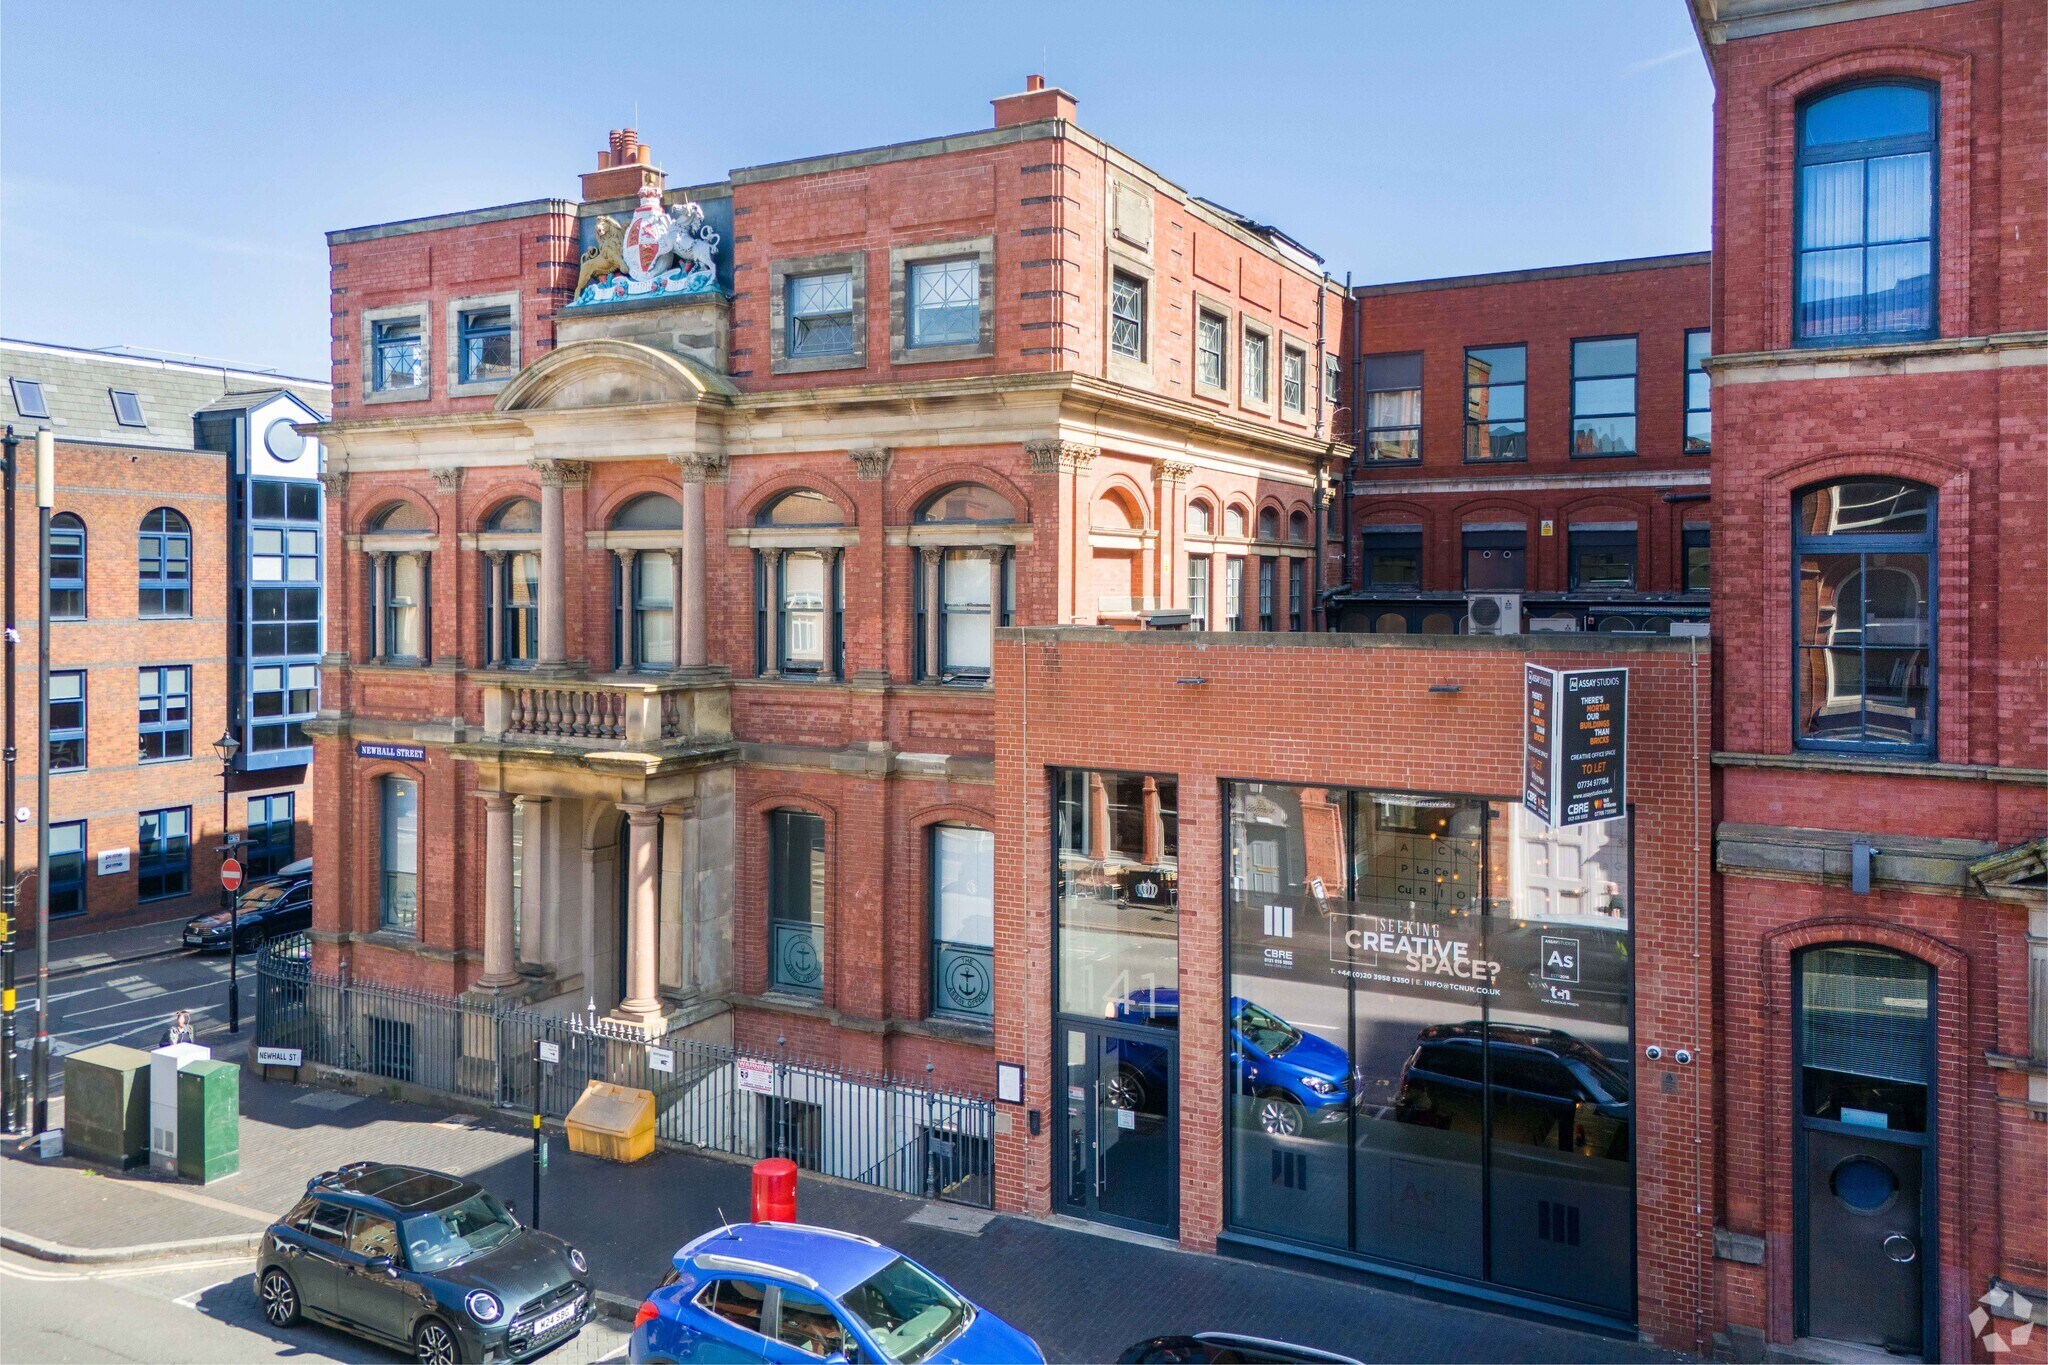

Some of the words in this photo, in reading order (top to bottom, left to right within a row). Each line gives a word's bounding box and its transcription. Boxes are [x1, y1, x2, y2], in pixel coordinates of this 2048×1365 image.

[1579, 679, 1597, 688] ASSAY
[1596, 677, 1620, 686] STUDIOS
[1580, 696, 1604, 704] THERE'S
[1586, 704, 1610, 712] MORTAR
[1580, 720, 1610, 730] BUILDINGS
[1594, 728, 1610, 736] THAN
[1590, 736, 1610, 745] BRICKS
[362, 746, 395, 756] NEWHALL
[396, 748, 424, 758] STREET
[1582, 764, 1592, 774] TO
[1594, 761, 1606, 773] LET
[1576, 780, 1592, 790] 07734
[1568, 802, 1589, 815] CBRE
[1380, 918, 1440, 938] SEEKING
[1345, 930, 1468, 961] CREATIVE
[1264, 948, 1293, 960] CBRE
[1548, 950, 1574, 968] As
[962, 957, 973, 965] THE
[1406, 952, 1501, 982] SPACE?
[1352, 971, 1372, 980] (0)20
[1374, 973, 1390, 982] 3958
[1392, 976, 1410, 984] 5350
[1424, 980, 1500, 996] INFO@TCNUK.CO.UK
[1082, 964, 1156, 1019] 141
[968, 990, 987, 1006] OFFICE
[260, 1052, 286, 1060] NEWHALL
[738, 1060, 772, 1073] WARNING
